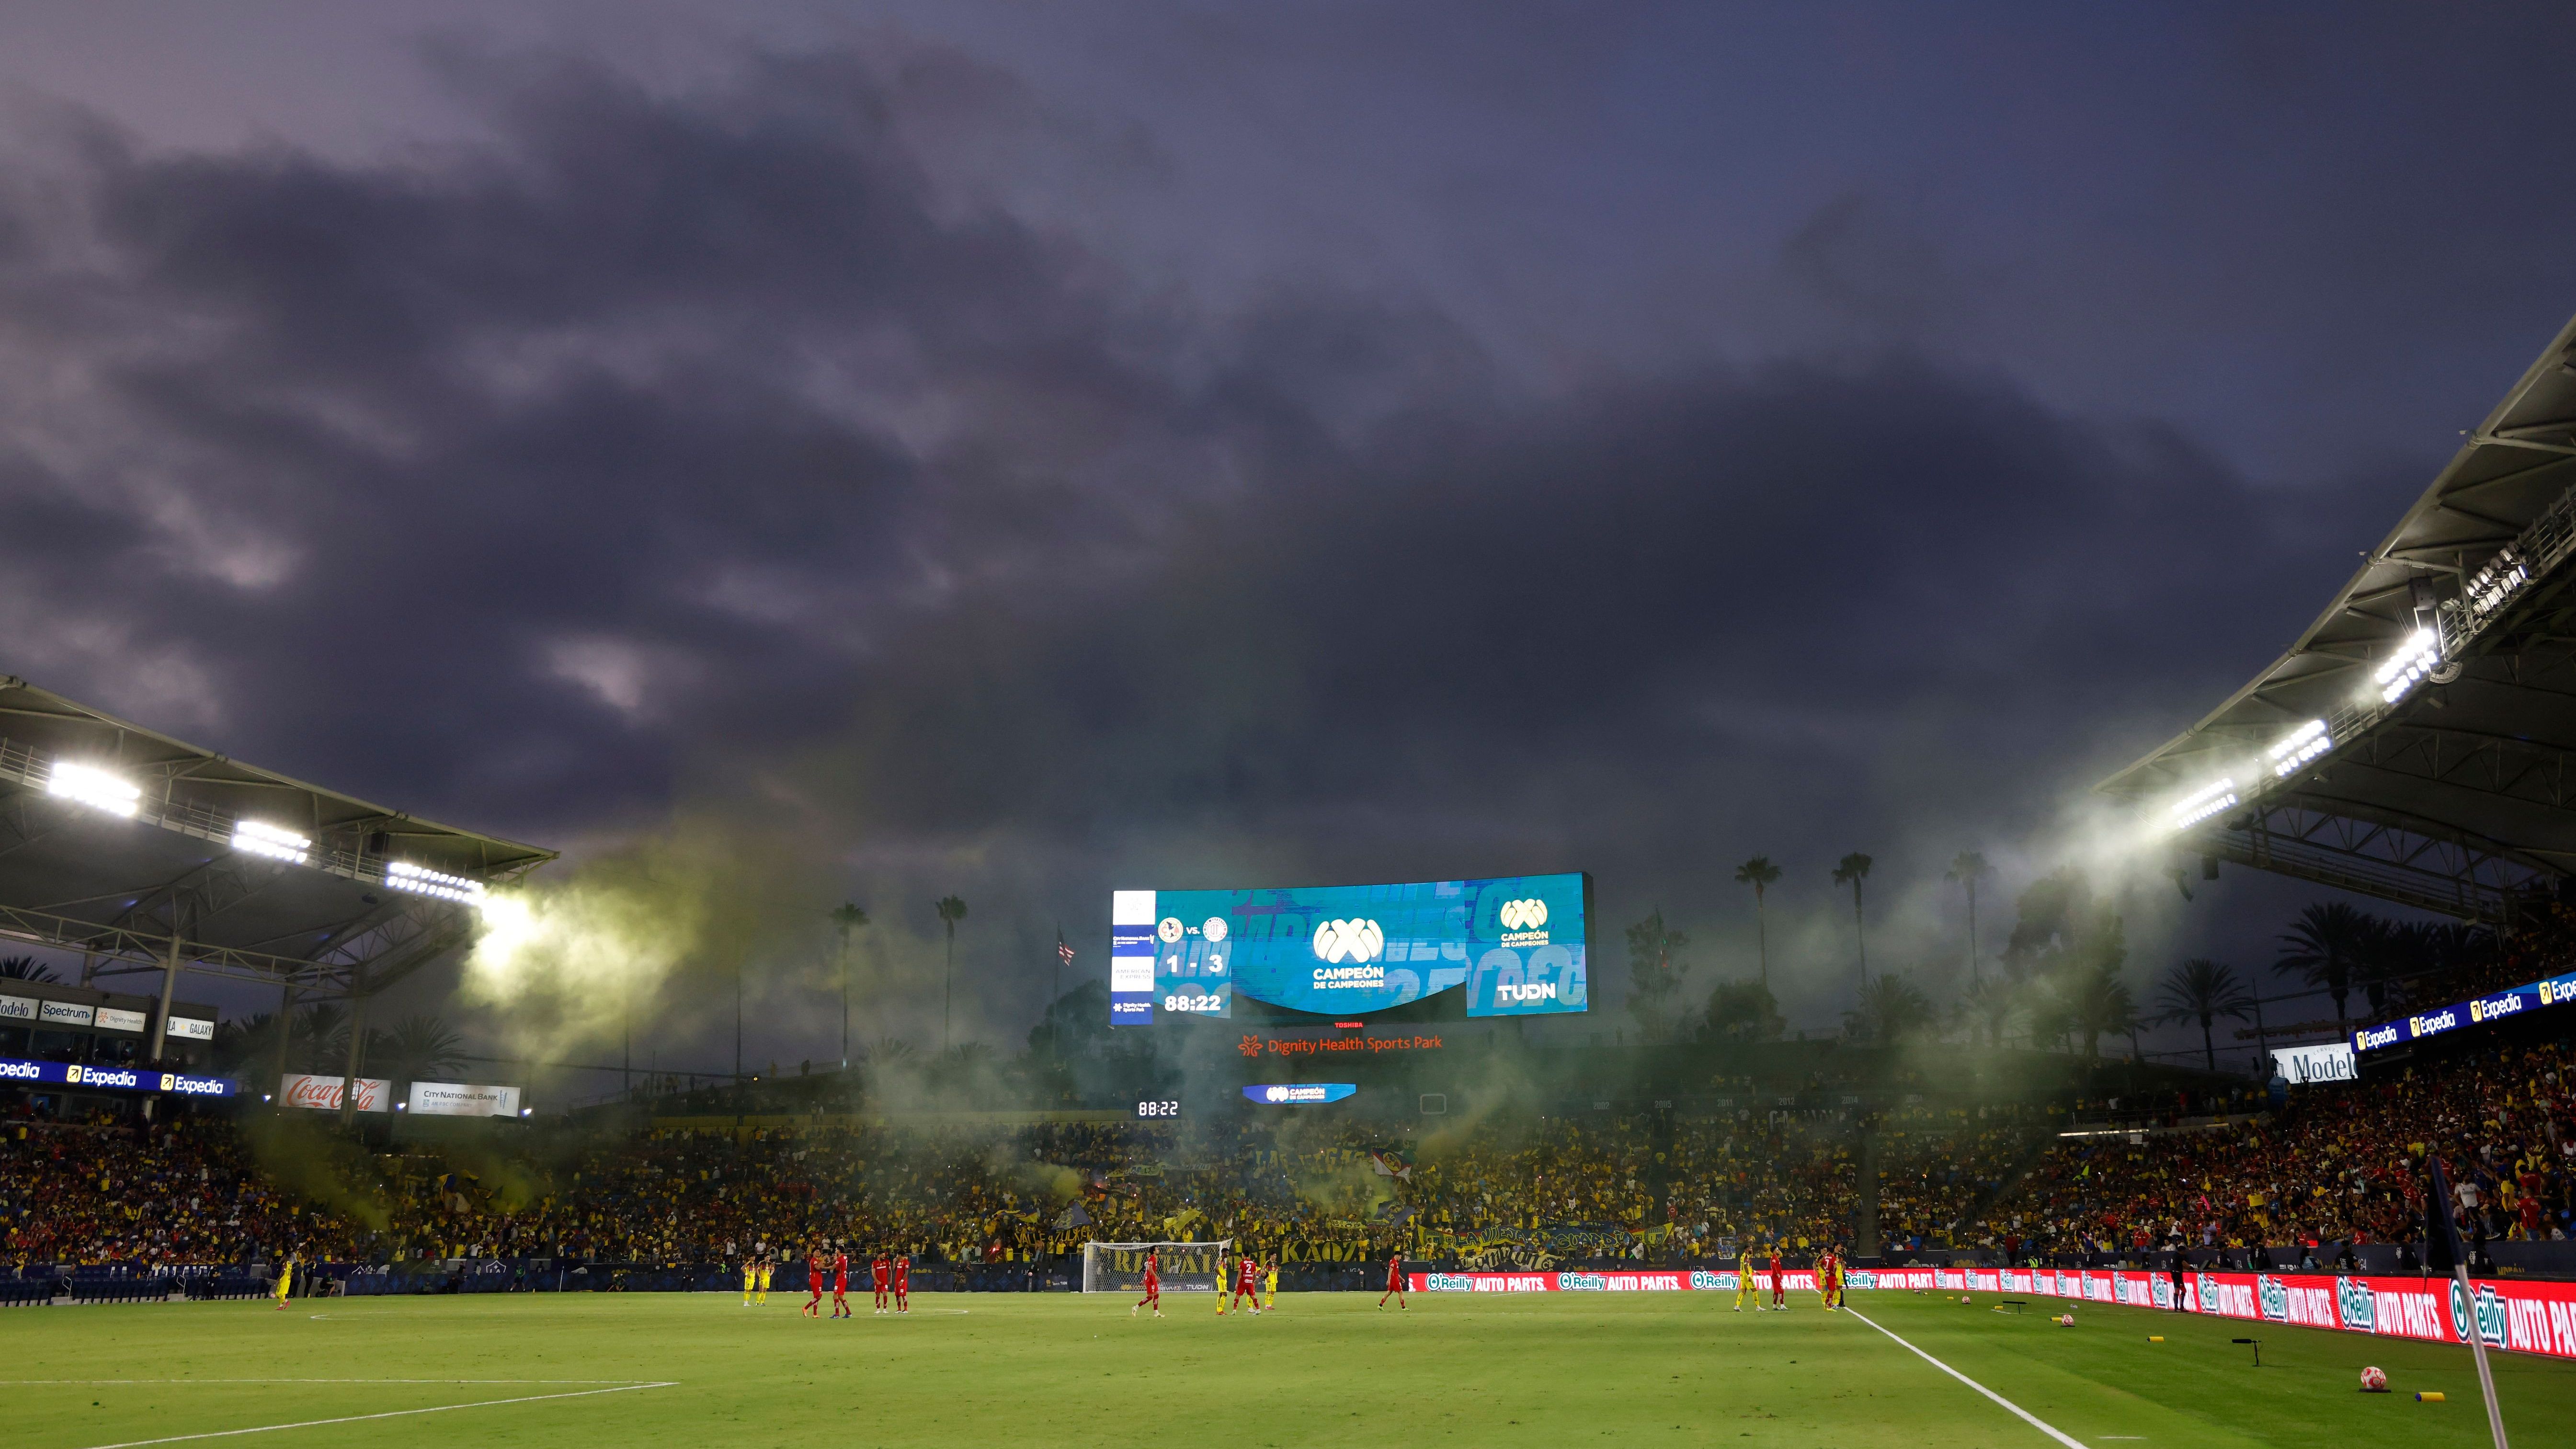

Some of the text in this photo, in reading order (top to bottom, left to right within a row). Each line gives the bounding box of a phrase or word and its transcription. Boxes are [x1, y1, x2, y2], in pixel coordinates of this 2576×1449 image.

[1186, 926, 1200, 935] VS.
[1501, 930, 1548, 942] CAMPEÓN
[1167, 955, 1177, 972] 1
[1208, 954, 1222, 972] 3
[1313, 964, 1383, 980] CAMPEÓN
[1313, 980, 1384, 989] DE CAMPEONES
[1498, 983, 1555, 1000] TUDN
[0, 999, 28, 1016] odelo
[43, 1004, 88, 1019] Spectrum
[1164, 995, 1221, 1011] 88:22
[2481, 993, 2522, 1019] Expedia
[110, 1016, 126, 1024] Dignity
[168, 1021, 213, 1036] LA GALAXY
[2419, 1010, 2455, 1035] Expedia
[1268, 1035, 1442, 1055] Dignity Health Sports Park
[2365, 1026, 2397, 1049] Expedia
[2314, 1047, 2339, 1055] CERVEZA
[82, 1068, 137, 1086] Expedia
[175, 1076, 224, 1094] Expedia
[287, 1076, 382, 1110] Coca-Cla
[441, 1091, 477, 1100] NATIONAL
[1289, 1087, 1325, 1095] CAMPEÓN
[1139, 1101, 1178, 1116] 88:22
[1778, 1097, 1794, 1106] 2012
[1246, 1264, 1251, 1273] 2
[1825, 1259, 1829, 1269] 7
[1428, 1274, 1473, 1291] O'Reilly
[1474, 1278, 1505, 1291] AUTO
[1560, 1272, 1605, 1290] O'Reilly
[1607, 1277, 1638, 1291] AUTO
[1691, 1271, 1739, 1289] O'Reilly
[1781, 1275, 1813, 1289] ARTS
[1845, 1272, 1877, 1289] Reilly
[1879, 1273, 1906, 1289] AUTO
[2219, 1284, 2234, 1315] AUTO
[2259, 1275, 2287, 1322] O'Reilly
[2288, 1287, 2307, 1323] AUTO
[2338, 1277, 2374, 1332] O'Reilly
[2375, 1291, 2404, 1335] AUTO
[2451, 1279, 2506, 1347] Oeilly
[2508, 1298, 2551, 1352] AUTO
